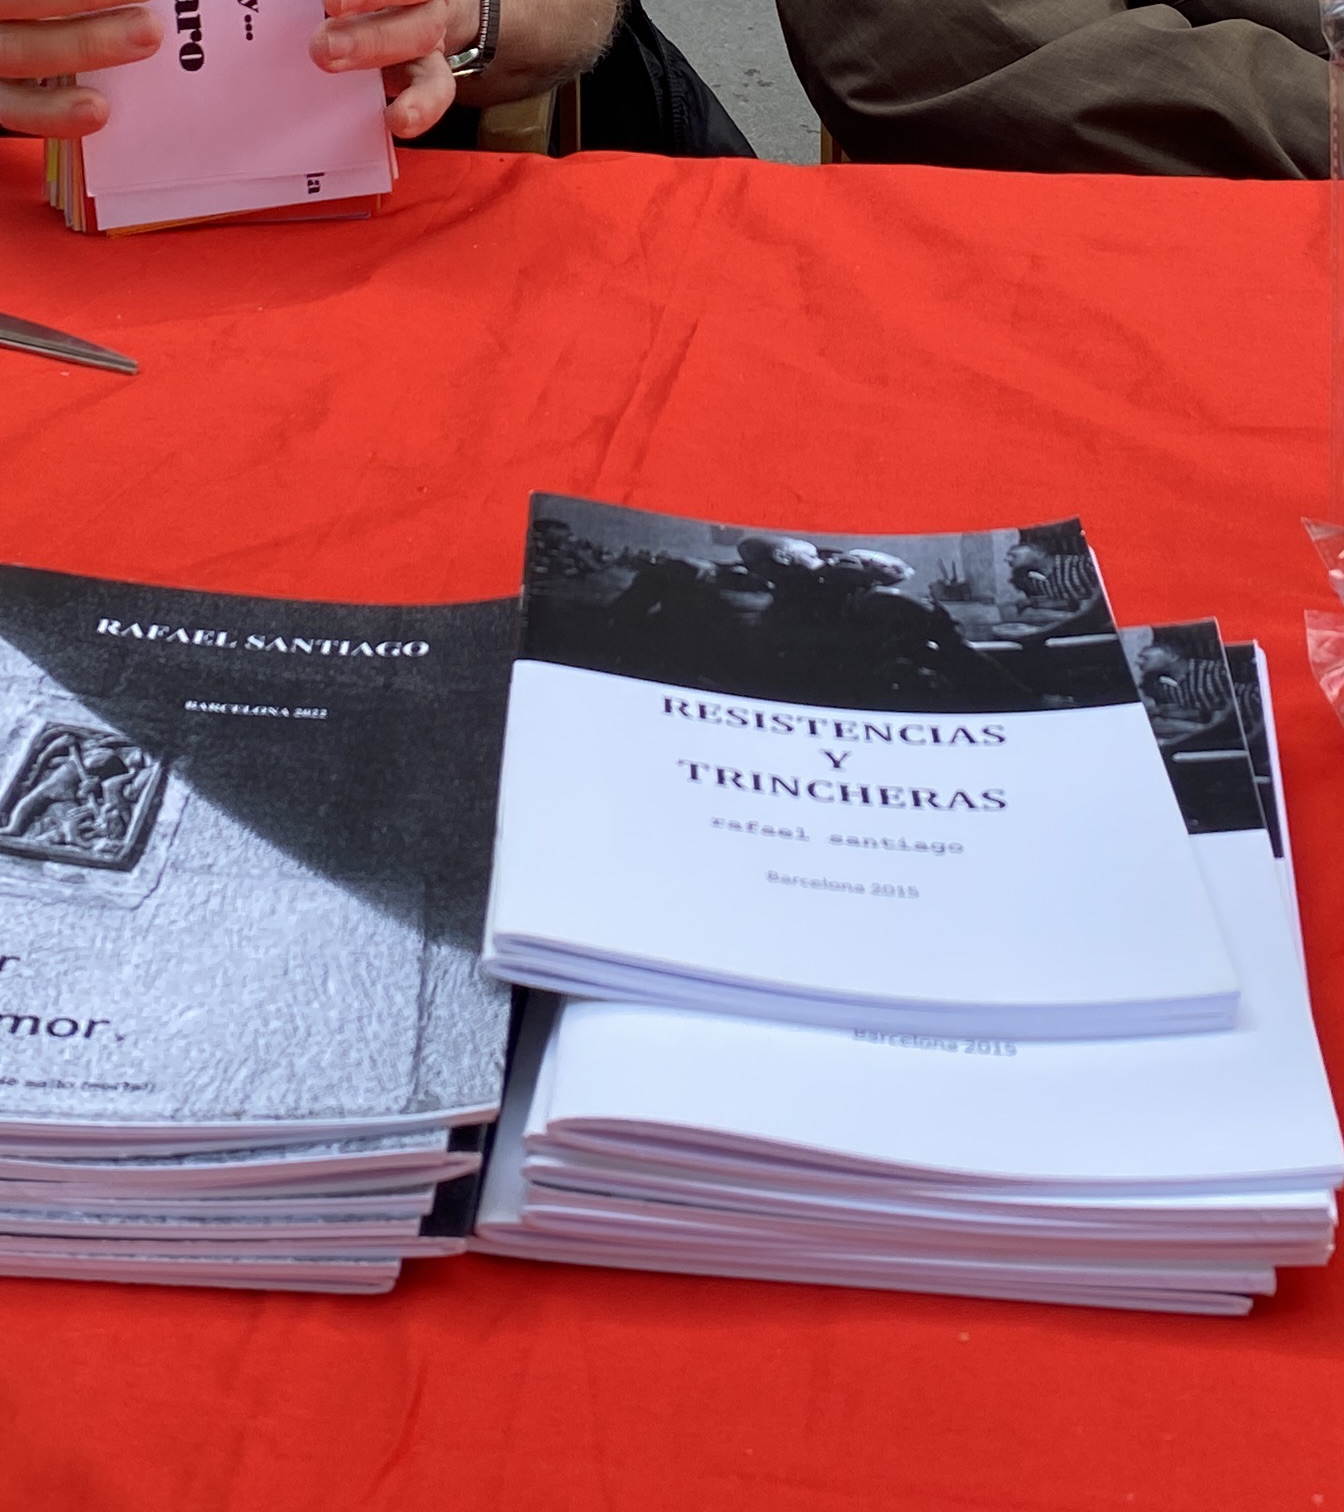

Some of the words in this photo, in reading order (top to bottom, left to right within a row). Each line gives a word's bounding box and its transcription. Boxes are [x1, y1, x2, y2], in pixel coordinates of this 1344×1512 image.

[97, 618, 237, 648] RAFAEL
[245, 635, 429, 657] SANTIAGO
[661, 696, 1007, 745] RESISTENCIAS
[821, 750, 851, 770] Y
[677, 760, 1008, 811] TRINCHERAS
[710, 816, 810, 842] rafael
[829, 834, 963, 857] santiago
[767, 870, 865, 895] Barcelona
